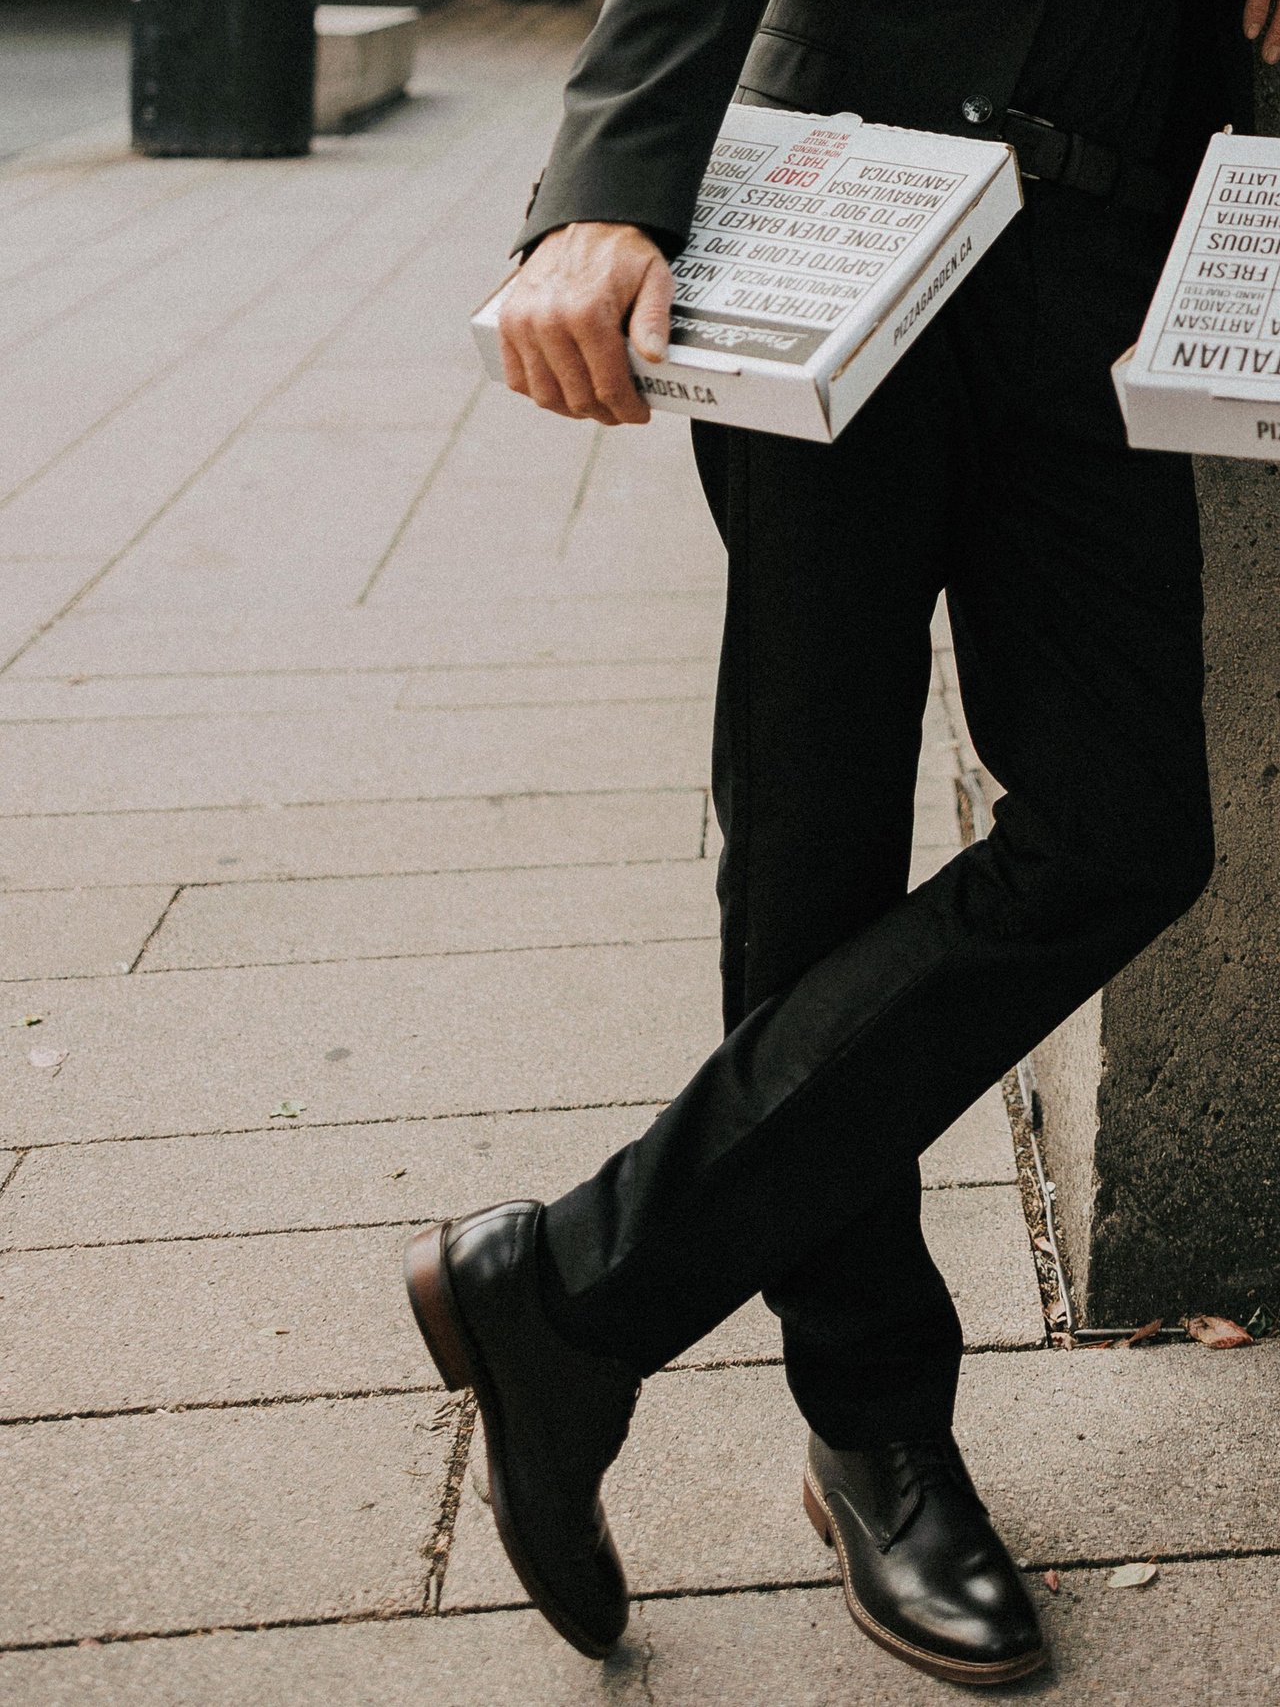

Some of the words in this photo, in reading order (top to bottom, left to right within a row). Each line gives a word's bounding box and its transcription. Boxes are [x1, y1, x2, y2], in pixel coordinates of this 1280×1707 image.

[810, 129, 840, 140] ITALIAN
[840, 133, 851, 141] IN
[730, 146, 767, 163] FIOR
[791, 145, 825, 156] FRIENDS
[827, 150, 843, 158] HOW
[833, 141, 848, 149] SAY
[783, 153, 830, 170] THAT'S
[764, 166, 820, 188] CIAO!
[859, 165, 957, 192] FANTASTICA
[1225, 170, 1278, 188] LATTE
[741, 189, 826, 214] DEGREES
[827, 180, 944, 208] MARAVILHOSA
[718, 210, 786, 235] BAKED
[869, 208, 897, 226] TO
[896, 213, 925, 230] UP
[784, 220, 841, 243] OVEN
[839, 230, 906, 252] STONE
[703, 237, 748, 257] TIPO
[747, 243, 807, 268] FLOUR
[671, 259, 722, 282] NAPL
[808, 250, 885, 278] CAPUTO
[1198, 261, 1269, 282] FRESH
[731, 269, 775, 286] PIZZA
[772, 277, 860, 299] NEAPOLITAN
[894, 236, 972, 346] PIZZAGARDEN.CA
[1184, 285, 1265, 300] HAND-CRAFTED
[725, 289, 847, 322] AUTHENTIC
[1180, 298, 1260, 316] PIZZAIOLO
[1173, 314, 1255, 334] ARTISAN
